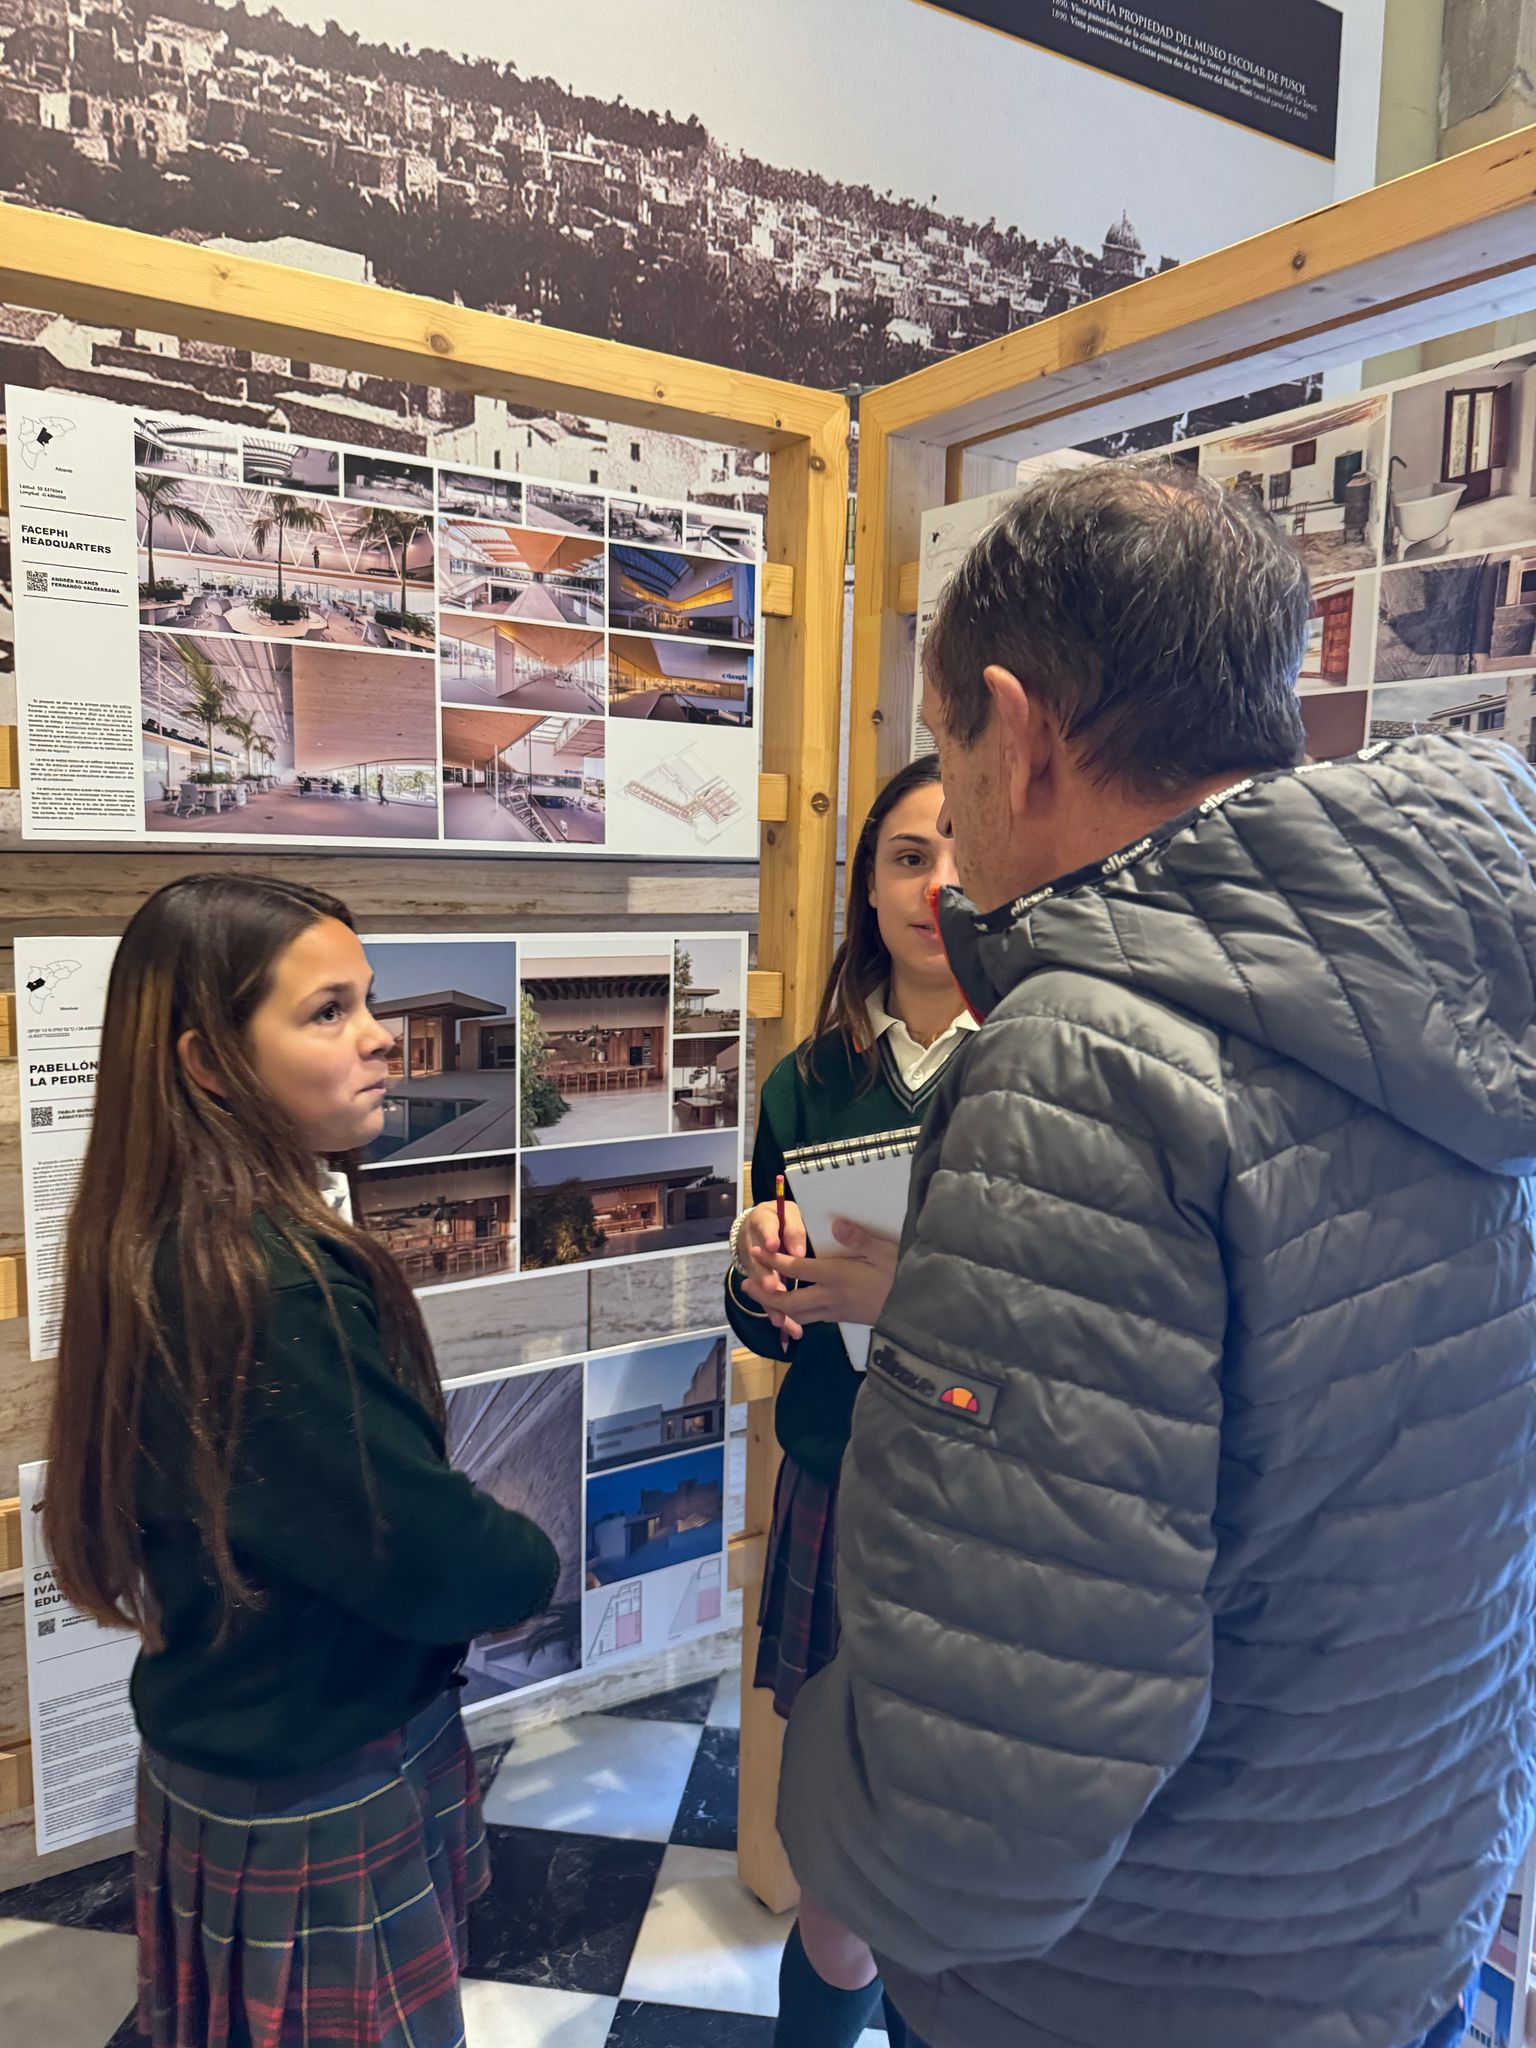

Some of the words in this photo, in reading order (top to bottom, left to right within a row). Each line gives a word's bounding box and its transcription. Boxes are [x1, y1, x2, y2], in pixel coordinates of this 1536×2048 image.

[1070, 2, 1087, 17] Vista
[1087, 12, 1124, 32] panorámica
[1124, 25, 1134, 36] de
[1133, 29, 1140, 39] la
[1140, 32, 1160, 47] ciudad
[1160, 41, 1183, 56] tomada
[1183, 48, 1200, 63] desde
[1207, 59, 1222, 71] Torre
[1221, 65, 1231, 77] del
[1070, 15, 1087, 30] Vista
[1122, 36, 1132, 47] de
[1132, 41, 1139, 51] la
[1139, 45, 1157, 58] ciutat
[1173, 58, 1183, 69] des
[1183, 62, 1192, 73] de
[1198, 67, 1214, 81] Torre
[1213, 74, 1223, 86] del
[1081, 0, 1117, 17] RAFÍA
[1119, 6, 1174, 39] PROPIEDAD
[1175, 30, 1193, 48] DEL
[1194, 39, 1227, 61] MUSEO
[1228, 53, 1266, 79] ESCOLAR
[1267, 69, 1279, 84] DE
[1280, 75, 1307, 96] PUSOL
[21, 524, 69, 538] FACEPHI
[21, 535, 112, 555] HEADQUARTERS
[51, 582, 82, 590] FERNANDO
[82, 585, 120, 594] VALDERRAMA
[1199, 778, 1255, 814] ellesse
[1101, 837, 1153, 875] ellesse
[1010, 886, 1055, 917] ellesse
[29, 1060, 99, 1074] PABELLÓN
[30, 1077, 47, 1087] LA
[51, 1073, 98, 1086] PEDRE
[35, 1594, 68, 1607] EDUV
